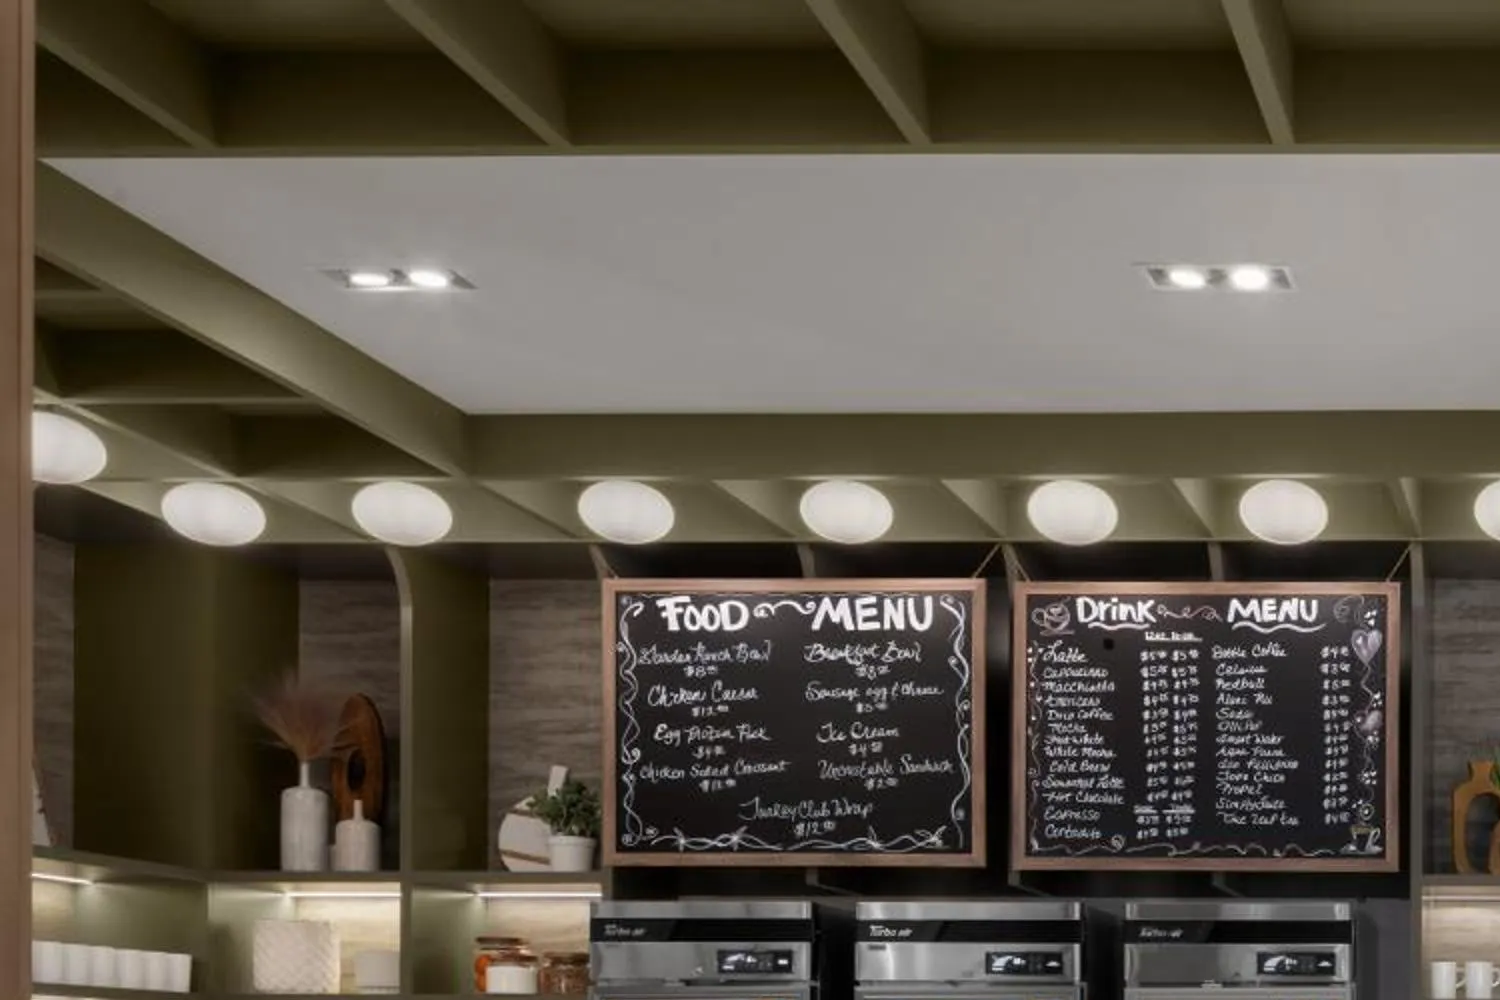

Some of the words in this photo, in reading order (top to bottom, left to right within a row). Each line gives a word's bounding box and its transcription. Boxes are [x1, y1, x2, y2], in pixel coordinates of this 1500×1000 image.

[656, 596, 749, 631] FOOD
[811, 596, 933, 632] MENU
[1075, 596, 1157, 623] Drink
[1227, 597, 1319, 623] MENU
[881, 640, 922, 663] Bowl
[1042, 640, 1088, 663] Latte
[648, 684, 706, 707] Chicken
[653, 723, 681, 747] Egg
[816, 722, 847, 743] Ice
[850, 721, 900, 739] Cream
[640, 763, 685, 784] Chicken
[738, 796, 798, 823] Turkey
[798, 800, 831, 818] Club
[831, 797, 874, 818] Wrap
[869, 925, 896, 937] Turbo
